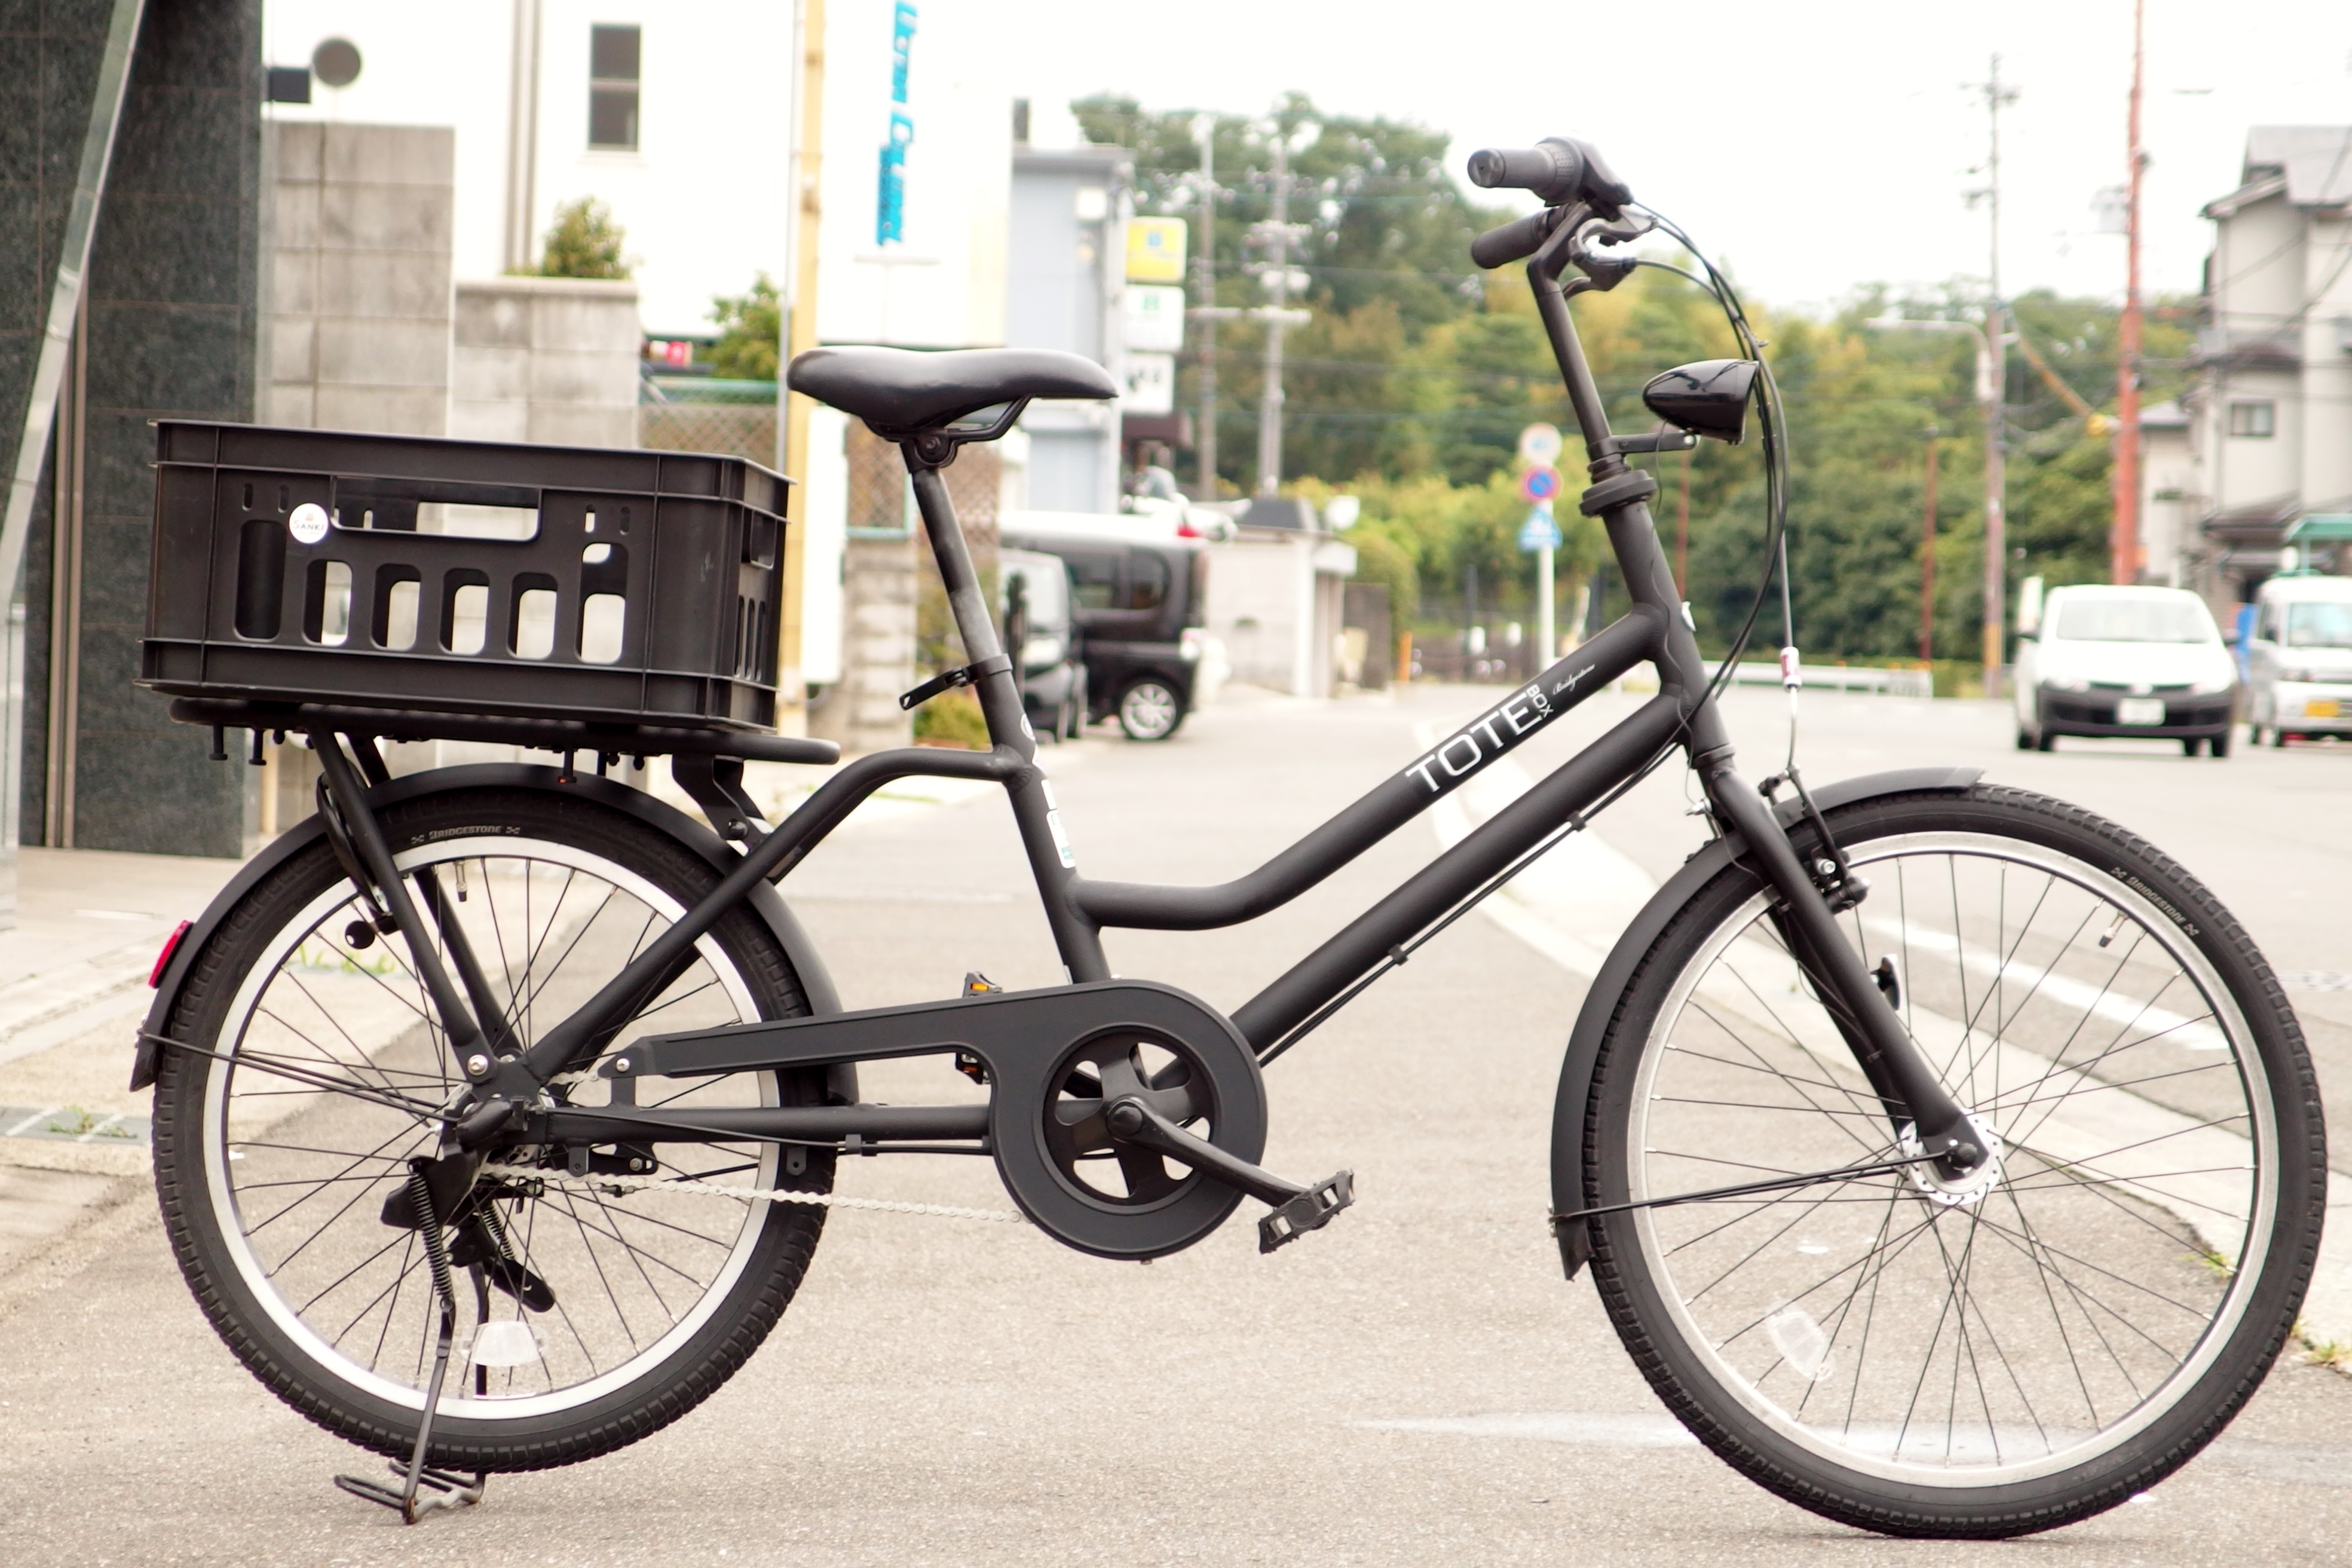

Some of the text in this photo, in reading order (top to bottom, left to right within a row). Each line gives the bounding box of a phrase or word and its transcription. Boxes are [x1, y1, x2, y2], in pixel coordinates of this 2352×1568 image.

[293, 519, 324, 531] SANKI
[1526, 684, 1554, 718] BOX
[1405, 692, 1543, 792] TOTE
[428, 825, 502, 840] BRIDGESTONE
[2126, 876, 2187, 924] BRIDGESTONE
